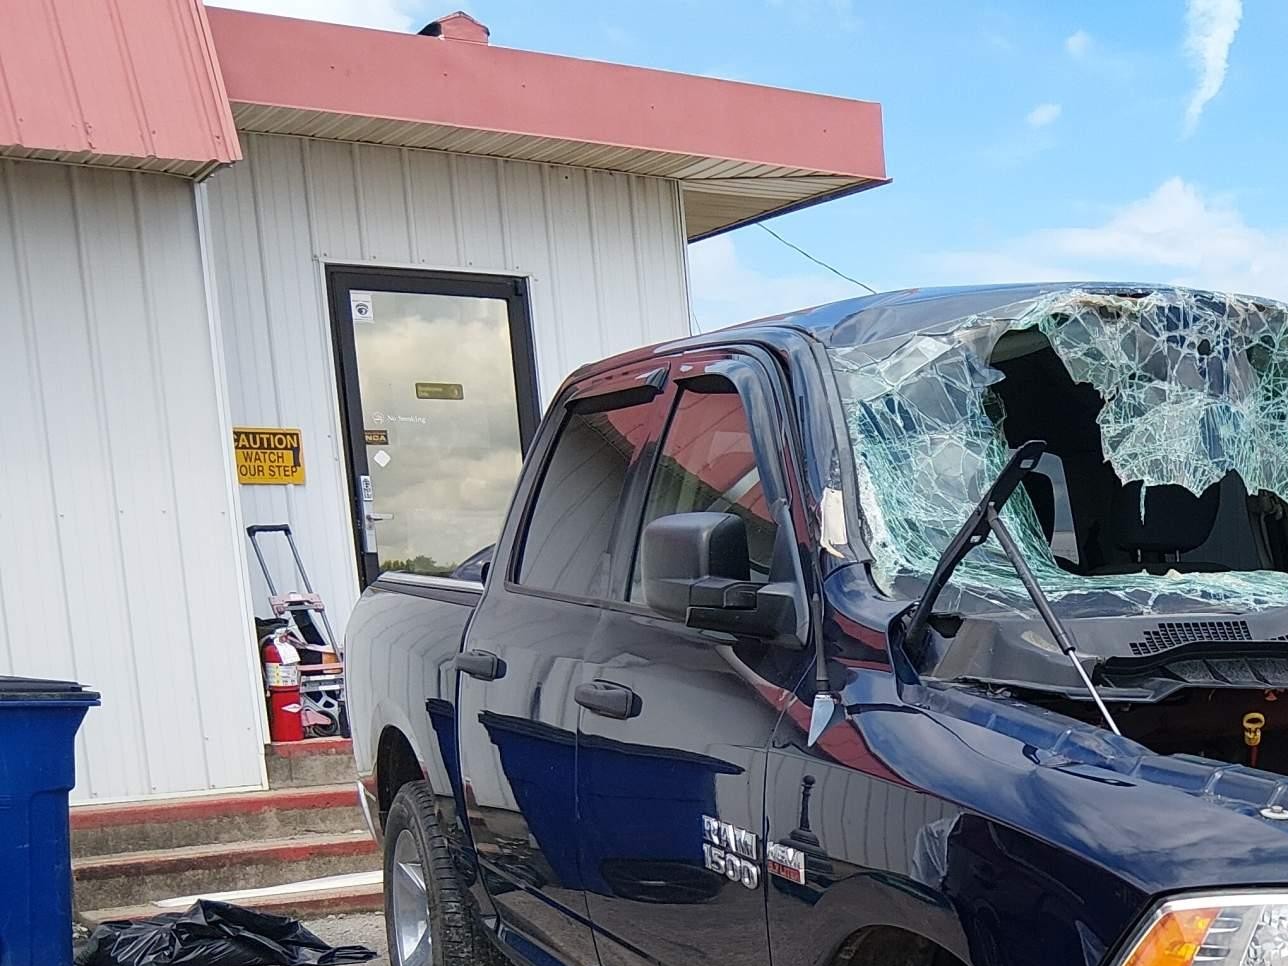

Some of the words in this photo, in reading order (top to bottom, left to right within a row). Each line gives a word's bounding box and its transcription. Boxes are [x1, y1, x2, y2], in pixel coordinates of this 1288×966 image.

[237, 464, 265, 477] OUR
[268, 464, 298, 477] STEP
[242, 450, 285, 463] WATCH
[701, 814, 758, 861] RAM
[702, 843, 761, 890] 1500
